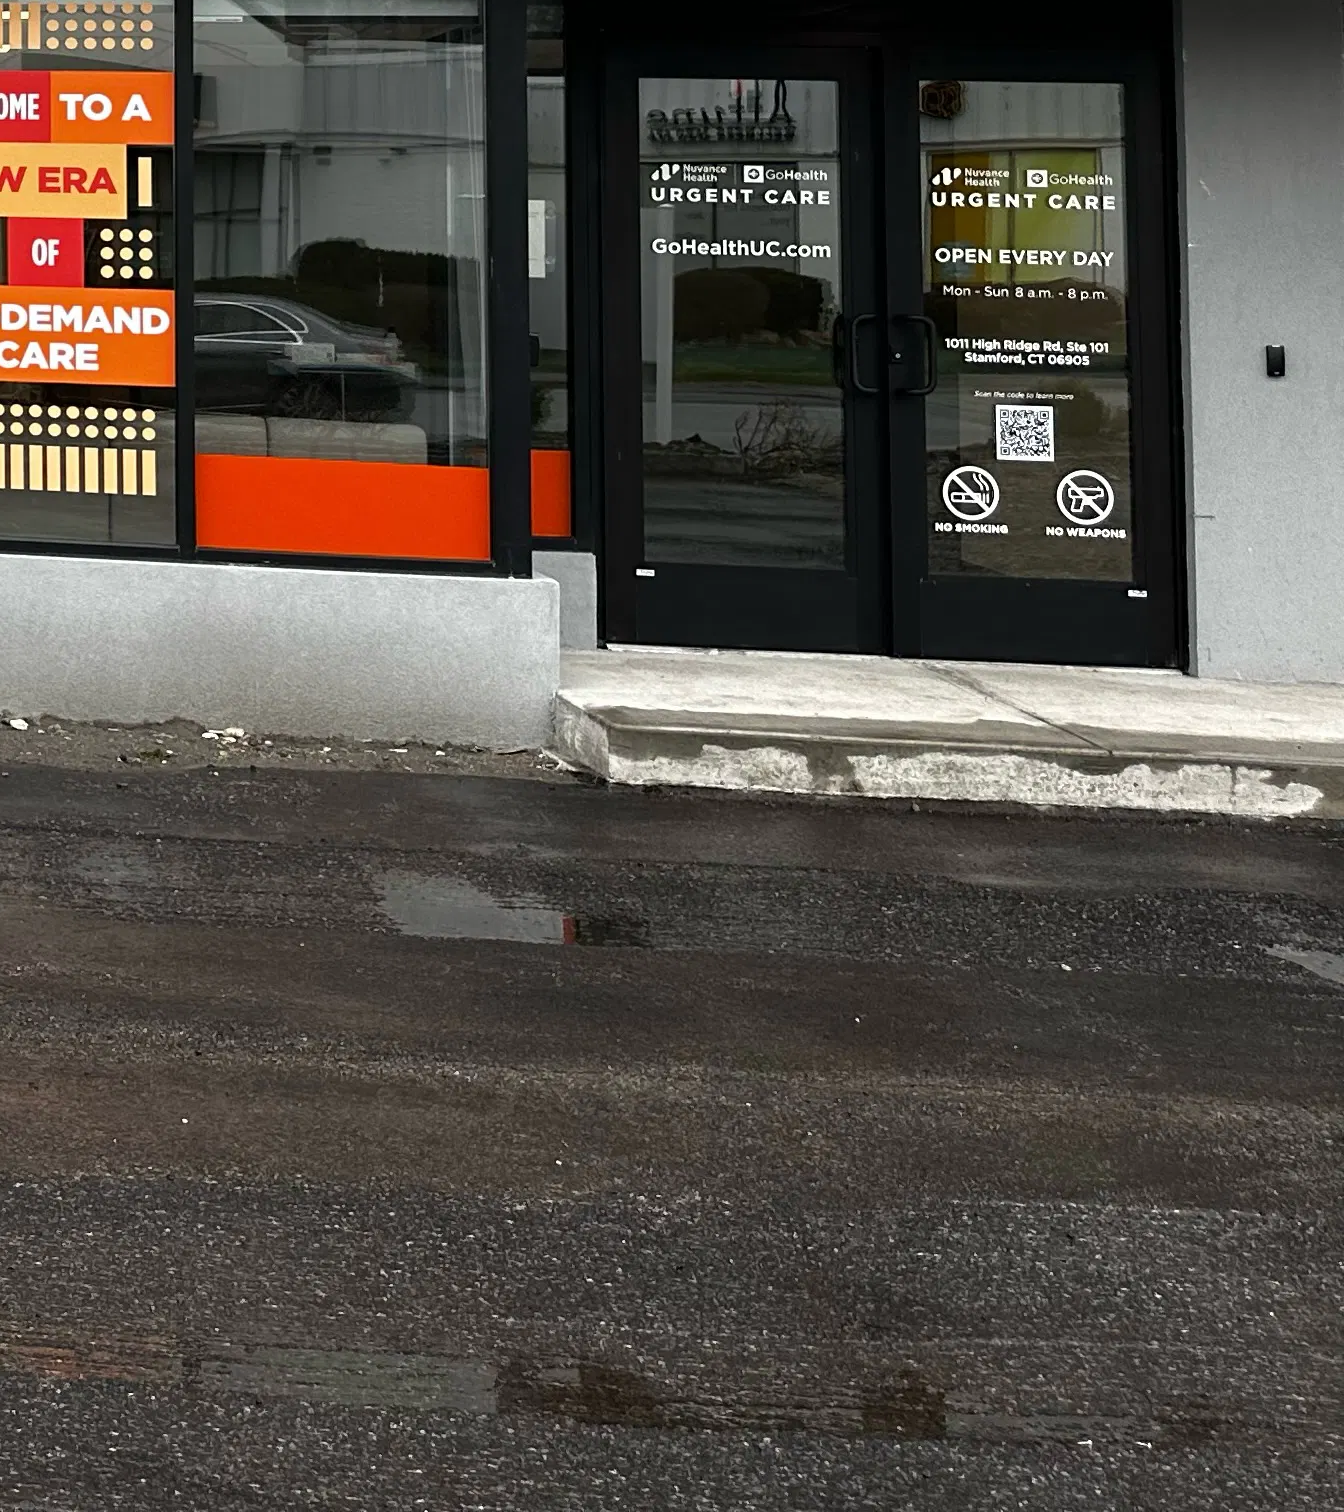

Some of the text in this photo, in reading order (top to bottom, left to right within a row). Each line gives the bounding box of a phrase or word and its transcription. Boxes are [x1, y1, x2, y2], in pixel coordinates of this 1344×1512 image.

[59, 94, 113, 121] TO
[121, 94, 152, 122] A
[683, 164, 727, 173] Nuvance
[965, 168, 1009, 178] Nuvance
[37, 167, 118, 194] ERA
[683, 174, 717, 182] Health
[766, 170, 828, 181] GoHealth
[965, 178, 999, 186] Health
[1049, 174, 1113, 185] GoHealth
[651, 188, 830, 204] URGENT CARE
[932, 192, 1116, 209] URGENT CARE
[32, 239, 60, 266] OF
[652, 239, 831, 257] GoHealthUC.com
[935, 248, 1114, 266] OPEN EVERY DAY
[943, 286, 971, 295] Mon
[984, 287, 1009, 297] Sun
[1015, 288, 1023, 297] 8
[1027, 290, 1054, 298] a.m.
[1068, 289, 1076, 299] 8
[1080, 290, 1108, 300] p.m.
[945, 338, 1108, 353] 1011 High Ridge Rd, Ste 101
[965, 352, 1089, 365] Stamford, CT 06905
[935, 523, 1008, 534] NO SMOKING
[1046, 527, 1126, 538] NO WEAPONS
